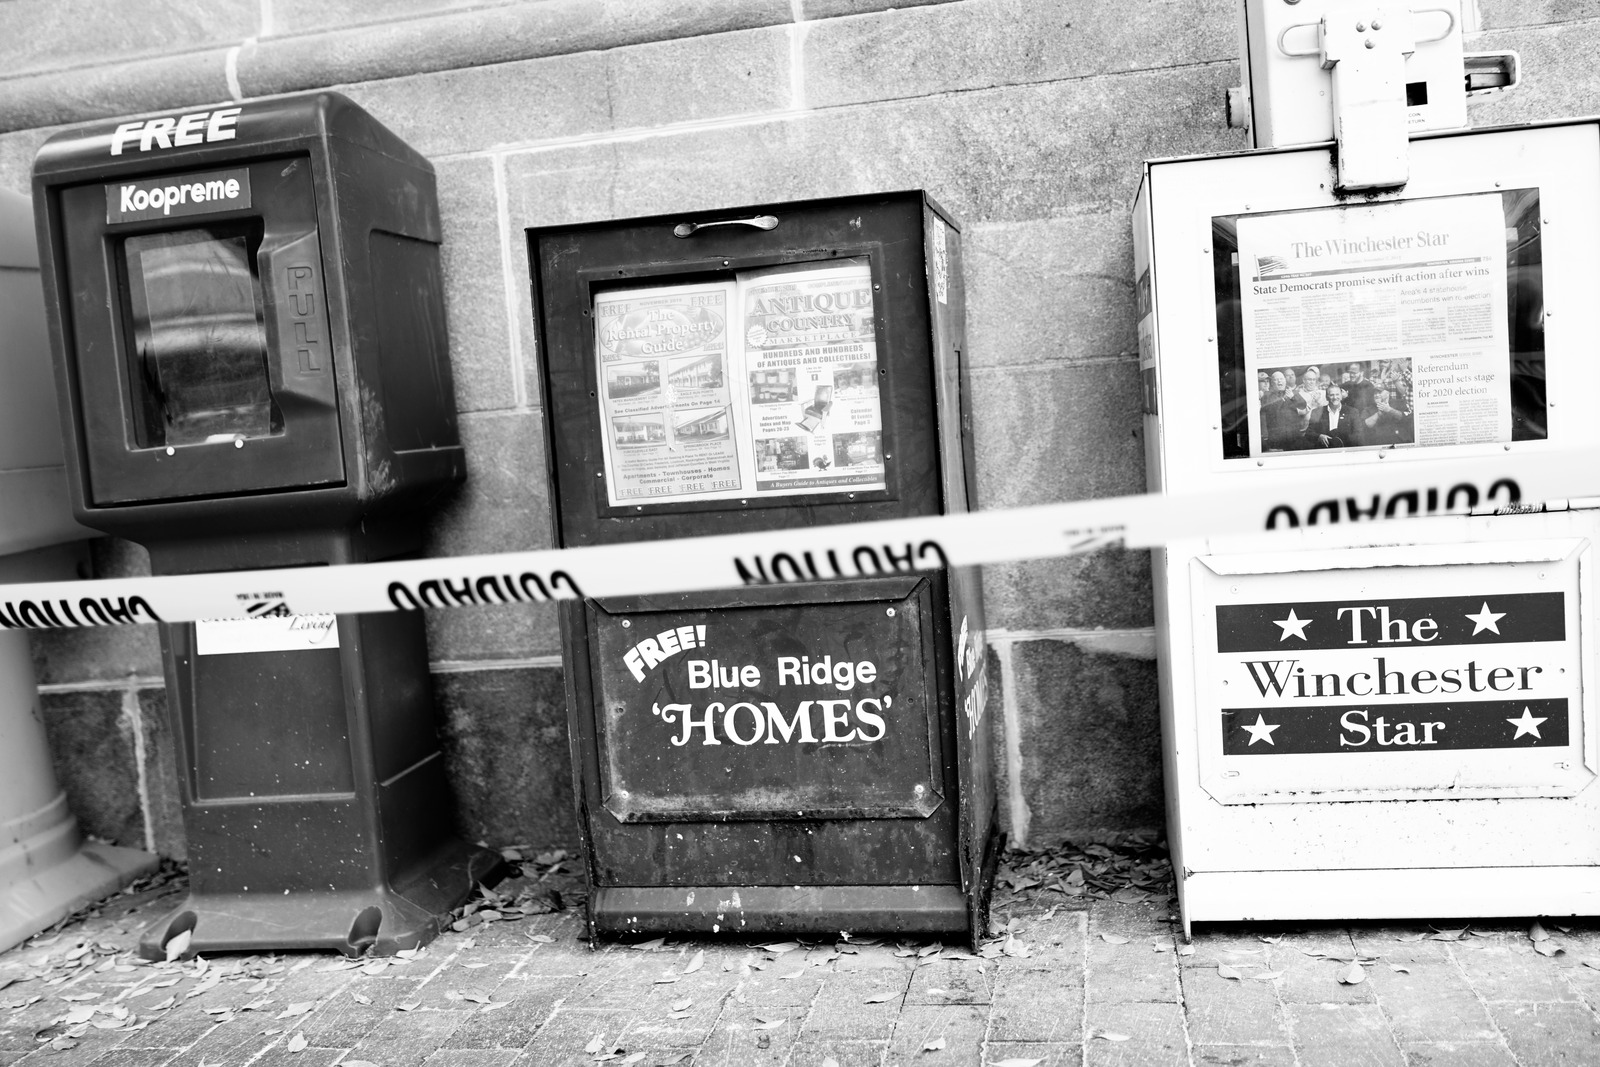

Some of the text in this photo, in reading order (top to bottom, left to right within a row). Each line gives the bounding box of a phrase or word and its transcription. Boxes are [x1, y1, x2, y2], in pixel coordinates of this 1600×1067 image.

[111, 107, 242, 156] FREE
[120, 178, 240, 215] Koopreme
[1291, 230, 1450, 258] The Winchester Star
[1253, 266, 1490, 296] State Democrats promise swift action after wins
[1400, 288, 1421, 296] Area's
[1429, 285, 1468, 294] statehouse
[1441, 294, 1454, 302] win
[690, 294, 723, 307] FREE
[749, 287, 871, 318] ANTIQUE
[601, 303, 632, 317] FREE
[647, 309, 675, 323] The
[607, 320, 718, 341] Rental Property
[766, 313, 857, 333] COUNTRY
[641, 339, 684, 355] Guide
[769, 332, 857, 345] MARKETPLACE
[763, 344, 864, 359] HUNDREDS AND HUNDREDS
[767, 358, 801, 367] ANTIQUES
[819, 353, 871, 363] COLLECTIBLES!
[1417, 362, 1469, 373] Referendum
[1417, 373, 1495, 387] approval sets stage
[1418, 386, 1488, 398] for 2020 election
[699, 399, 713, 407] Page
[623, 472, 657, 480] Apartments
[662, 468, 702, 476] Townhouses
[681, 473, 714, 482] Corporate
[620, 479, 737, 496] FREE FREE FREE FREE
[733, 540, 949, 586] CAUTION
[387, 570, 585, 610] CUIDADO
[288, 616, 335, 644] Living
[1336, 605, 1440, 645] The
[623, 625, 707, 683] FREE!
[687, 655, 877, 691] Blue Ridge
[1240, 656, 1543, 699] Winchester
[652, 695, 892, 747] 'HOMES'
[1339, 709, 1446, 747] Star
